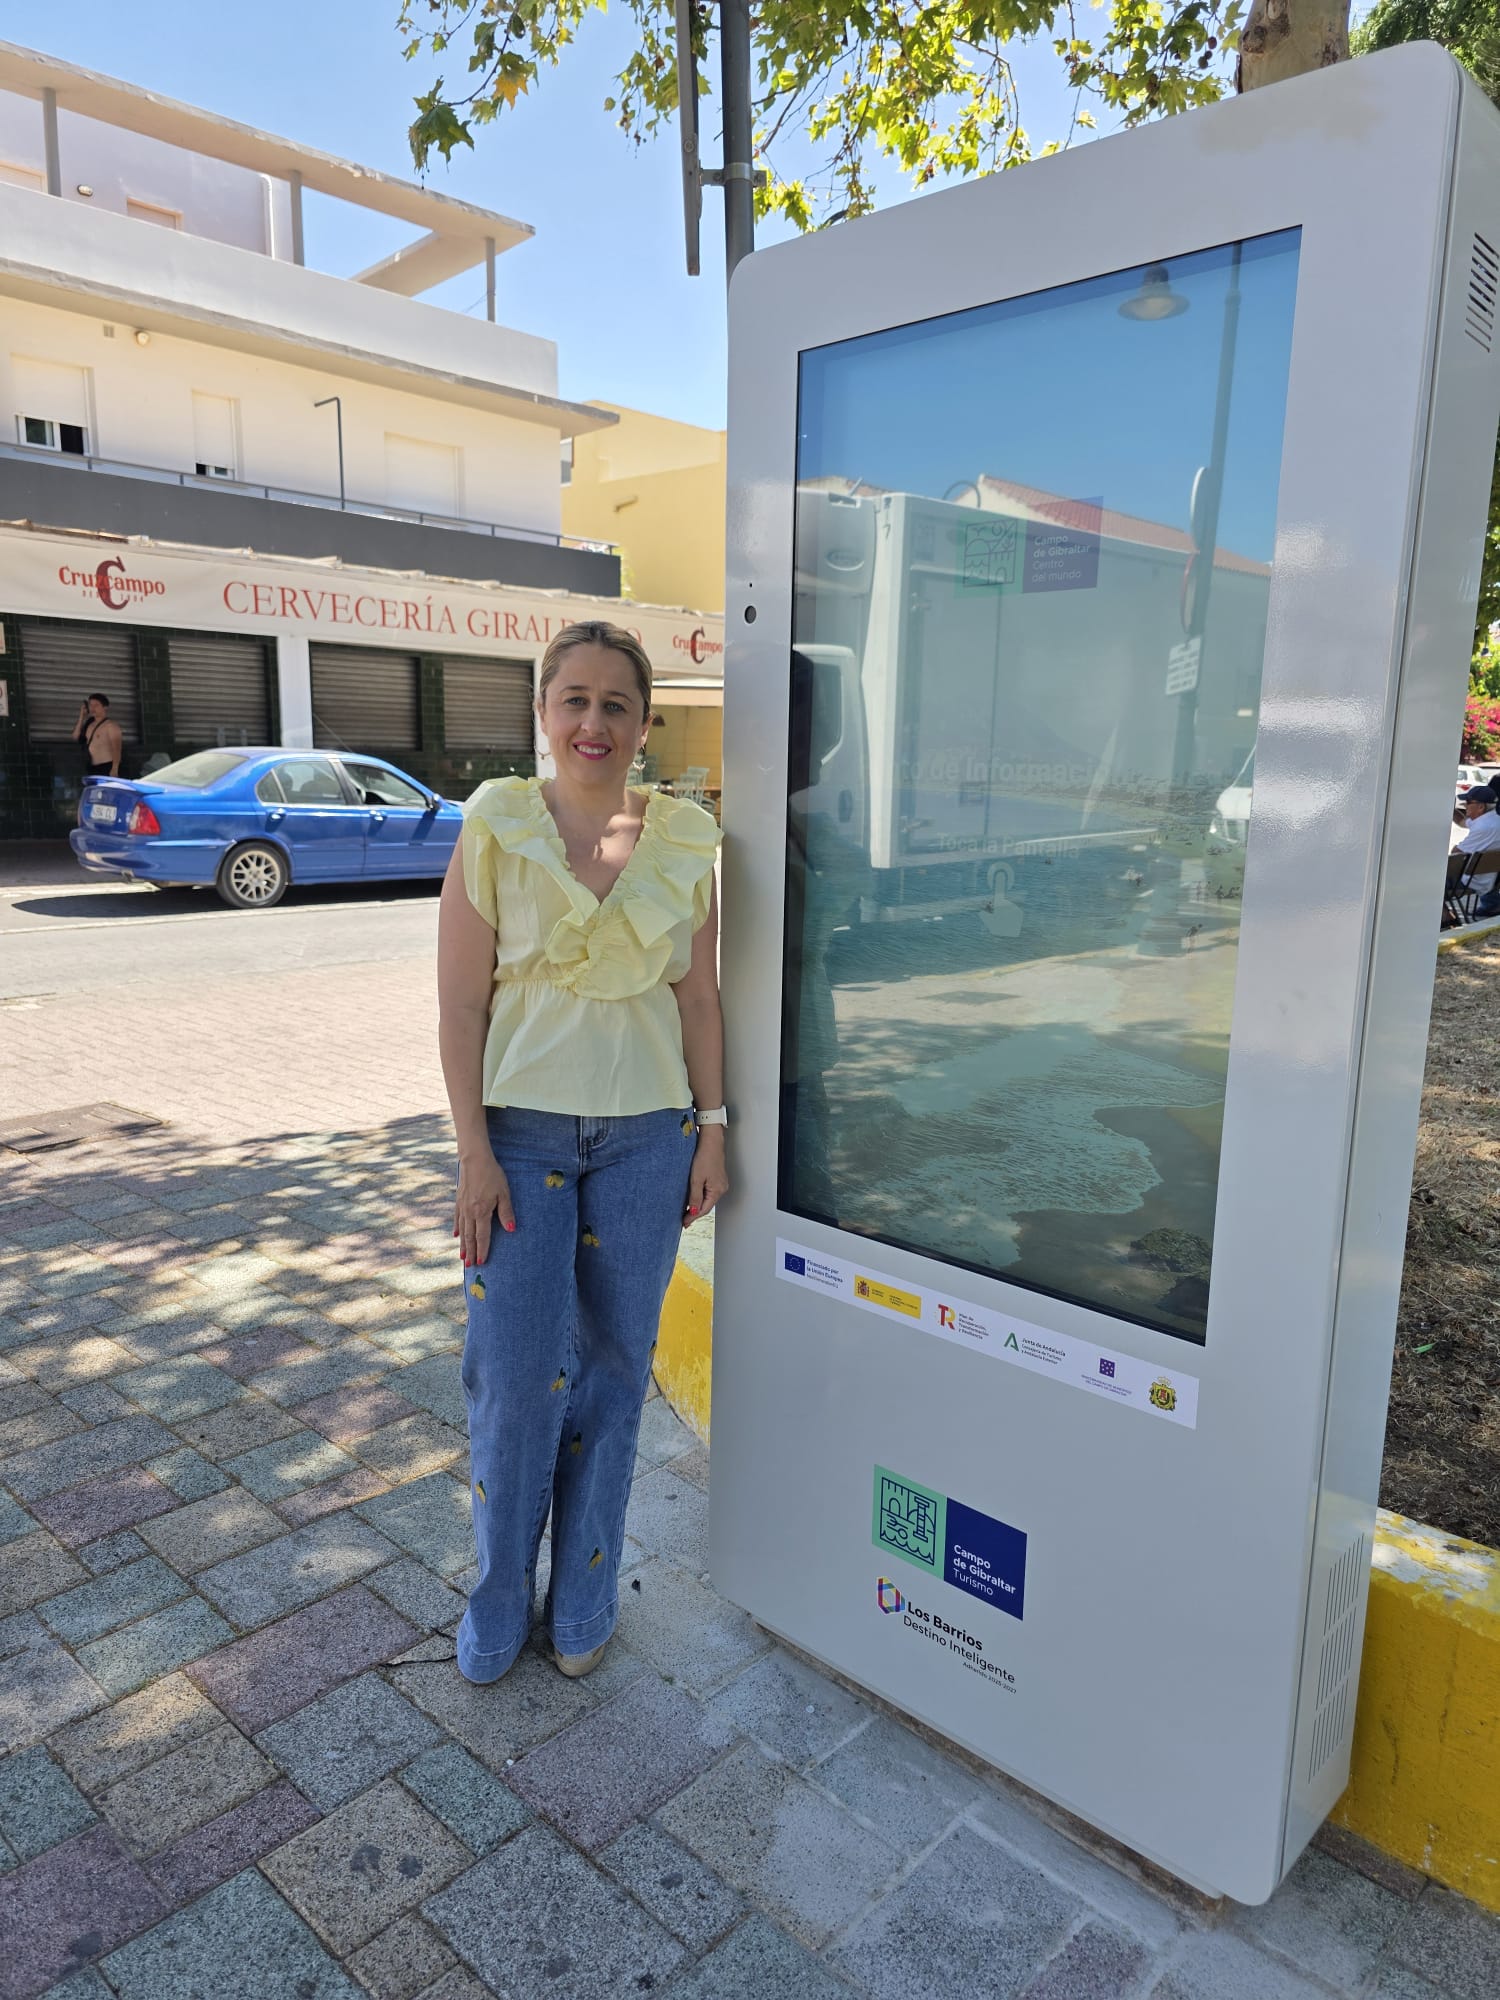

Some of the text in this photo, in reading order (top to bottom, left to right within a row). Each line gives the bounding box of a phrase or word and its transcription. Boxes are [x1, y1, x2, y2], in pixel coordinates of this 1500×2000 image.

[1032, 544, 1091, 559] de Gibraltar
[1033, 535, 1069, 546] Campo
[1031, 559, 1065, 571] Centro
[1031, 569, 1082, 583] del mundo
[58, 565, 166, 596] Cruzcampo
[222, 581, 458, 635] CERVECERÍA
[1022, 1337, 1036, 1347] Junta
[953, 1544, 991, 1569] Campo
[953, 1556, 1017, 1595] de Gibraltar
[953, 1568, 994, 1597] Turismo
[907, 1601, 984, 1651] Los Barrios
[903, 1615, 1016, 1684] Destino Inteligente
